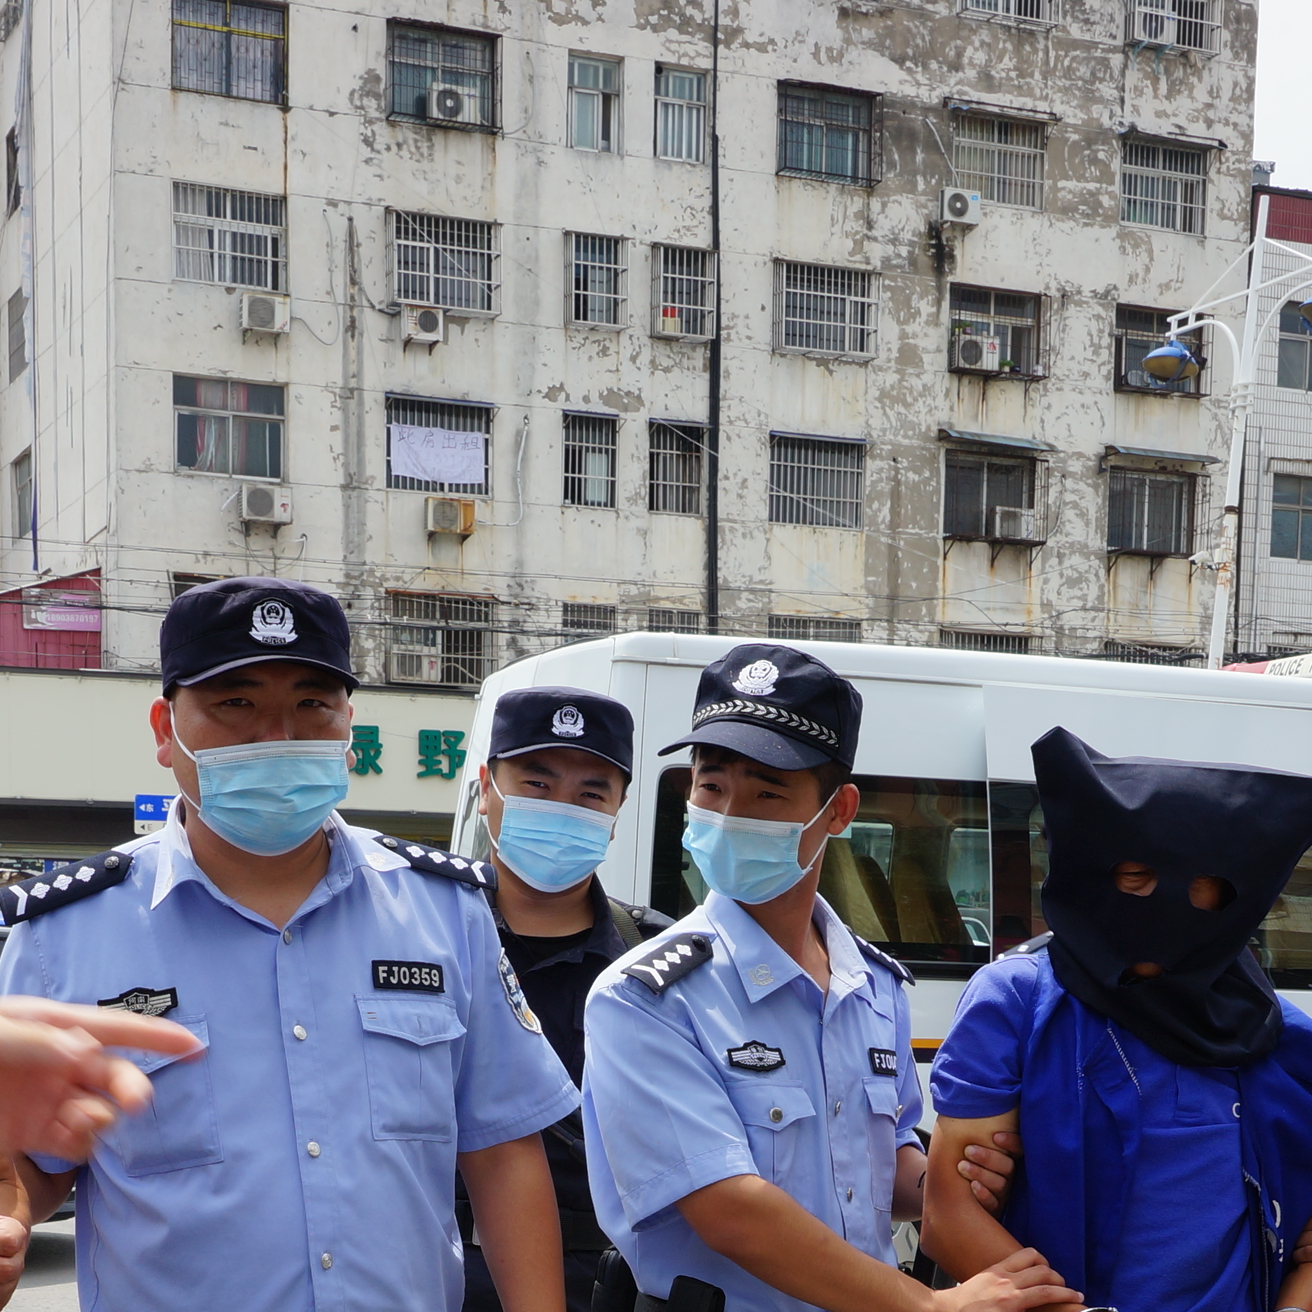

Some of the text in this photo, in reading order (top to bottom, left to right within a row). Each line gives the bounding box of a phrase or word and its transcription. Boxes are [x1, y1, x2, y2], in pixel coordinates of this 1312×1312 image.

[397, 428, 481, 450] 此房出租
[1268, 657, 1305, 676] POLICE
[378, 966, 440, 987] FJ0359
